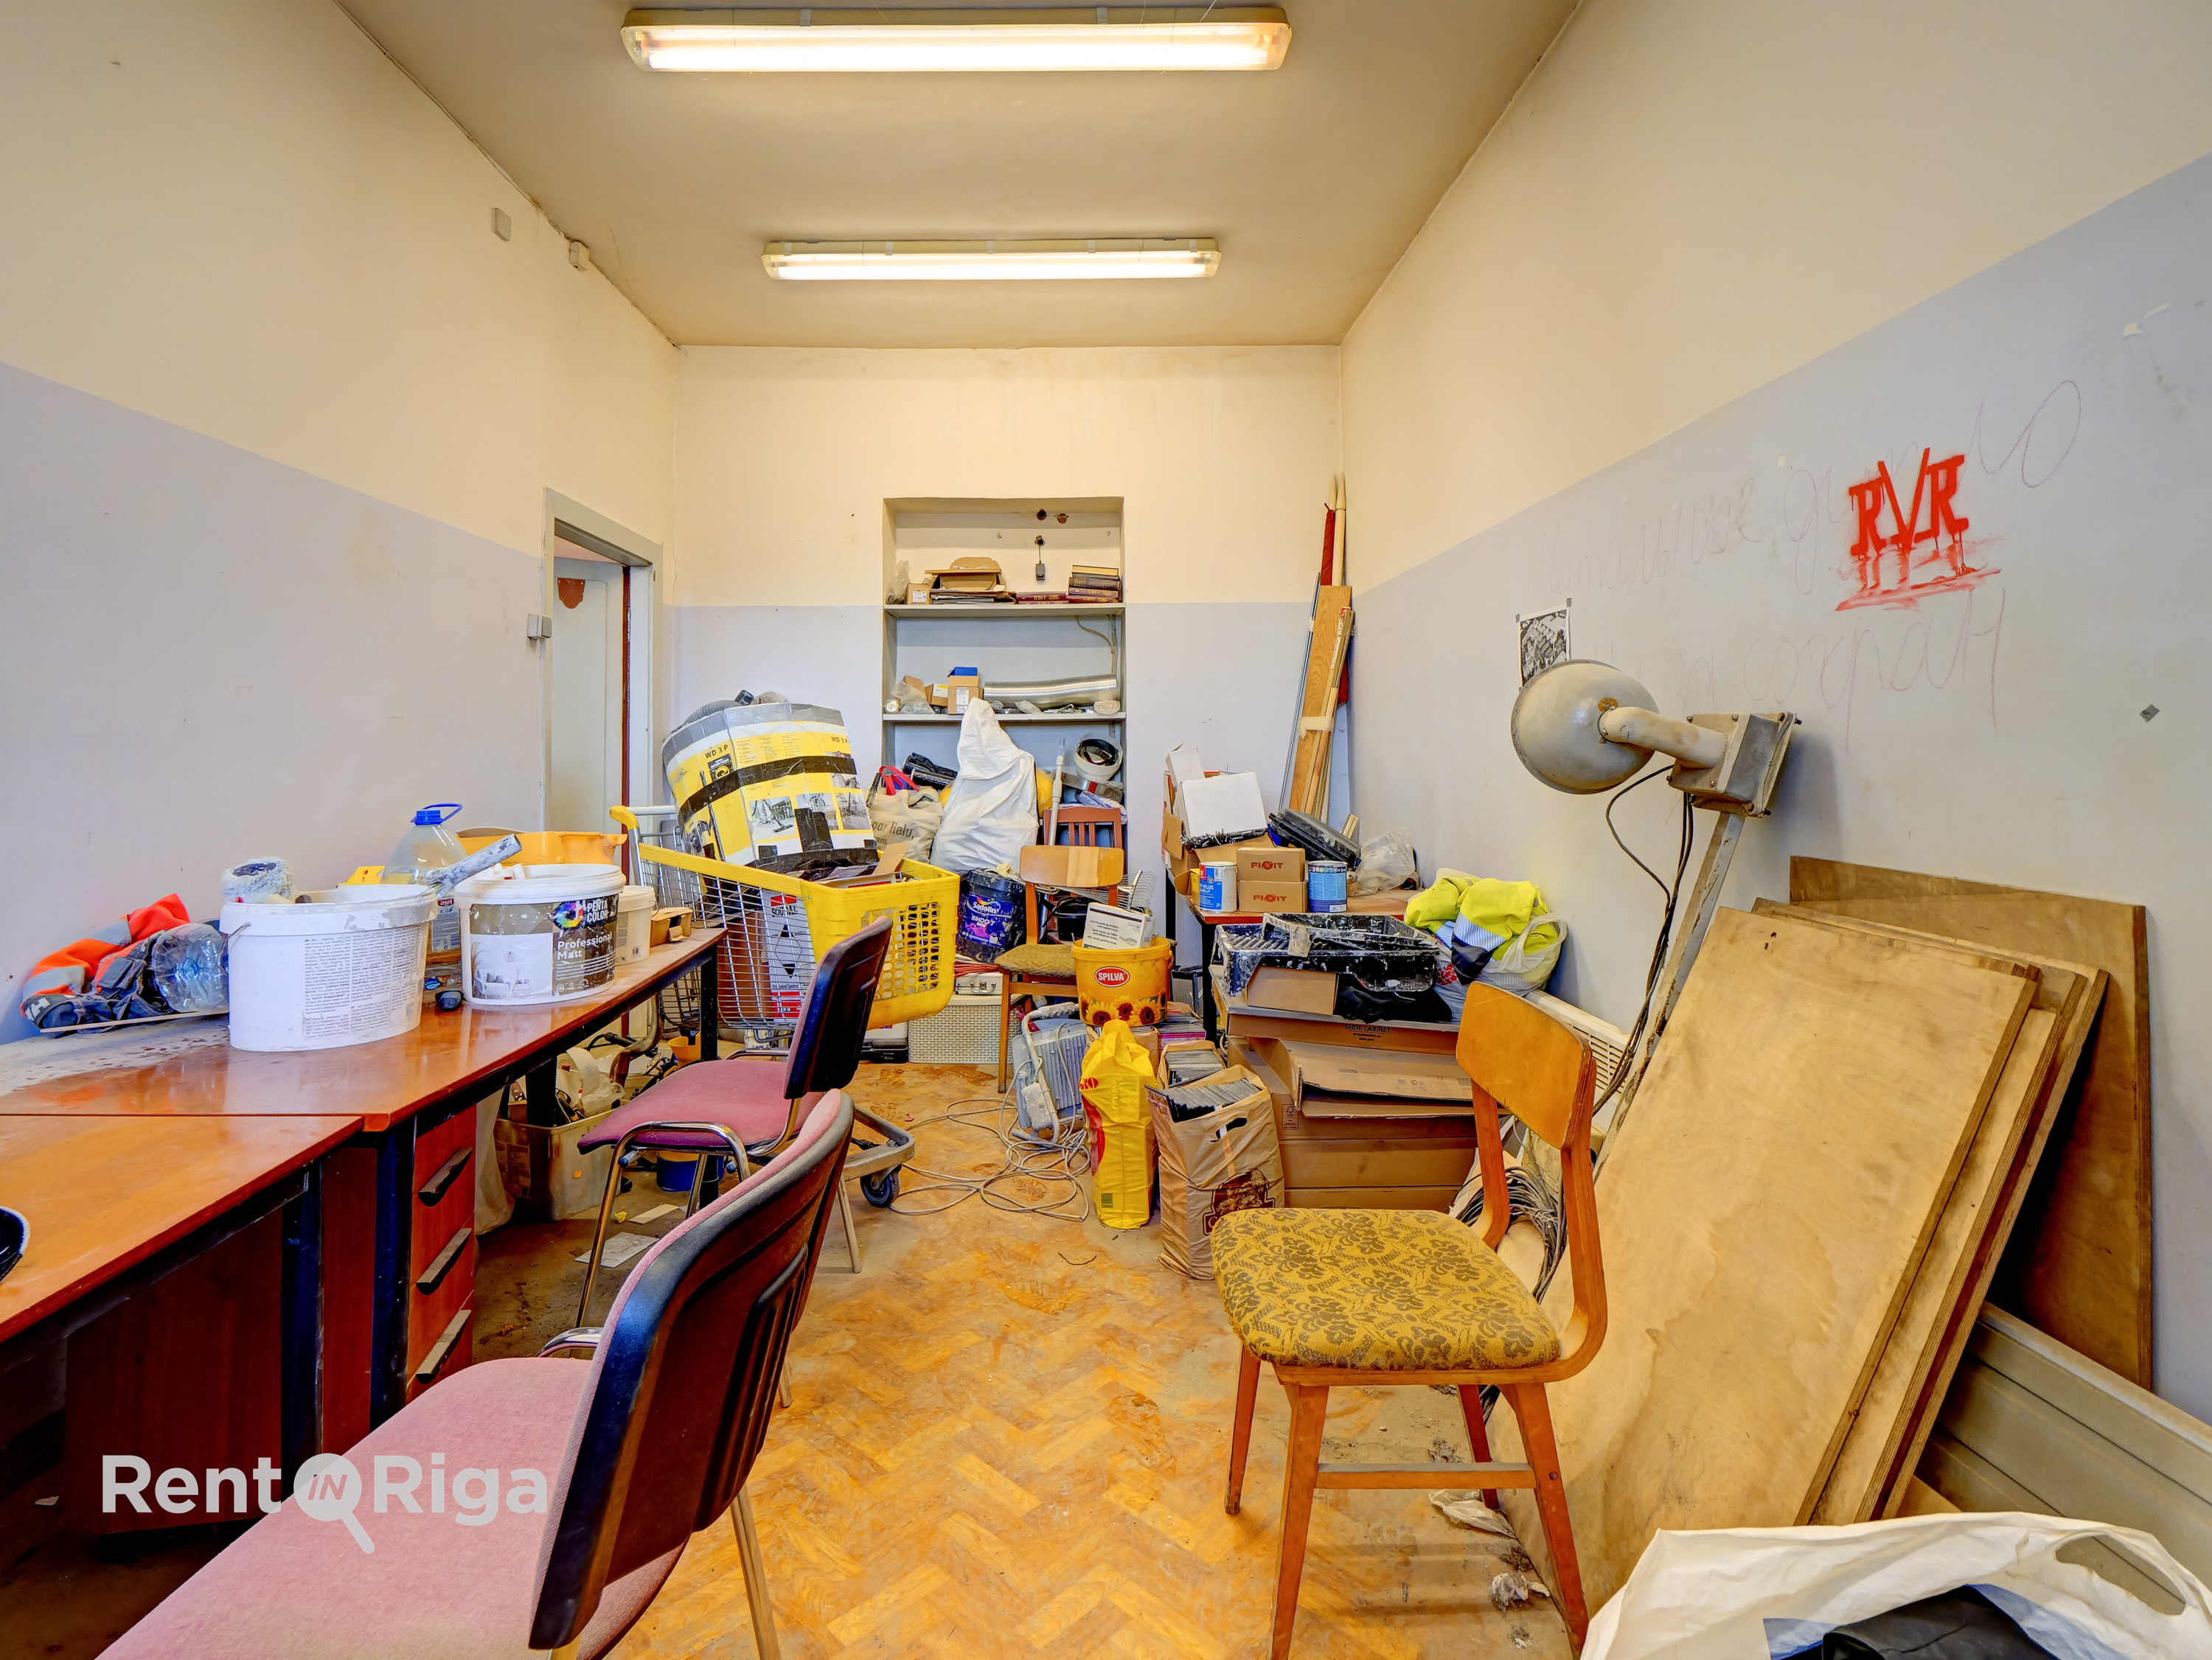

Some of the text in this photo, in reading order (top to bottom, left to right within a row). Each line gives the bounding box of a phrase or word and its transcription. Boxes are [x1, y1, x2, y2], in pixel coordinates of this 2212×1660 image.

[1848, 447, 1969, 557] RVR
[705, 750, 717, 759] WD
[889, 820, 914, 840] lielu,
[874, 837, 888, 845] azu.
[1251, 860, 1284, 871] FIXIT
[1253, 893, 1287, 903] FIXIT
[587, 900, 608, 913] PENTA
[973, 902, 996, 914] Sadolin
[587, 910, 609, 922] COLOR
[971, 915, 990, 924] BINDO
[557, 932, 613, 950] Professional
[557, 949, 583, 960] Matt
[1098, 972, 1125, 981] SPILVA
